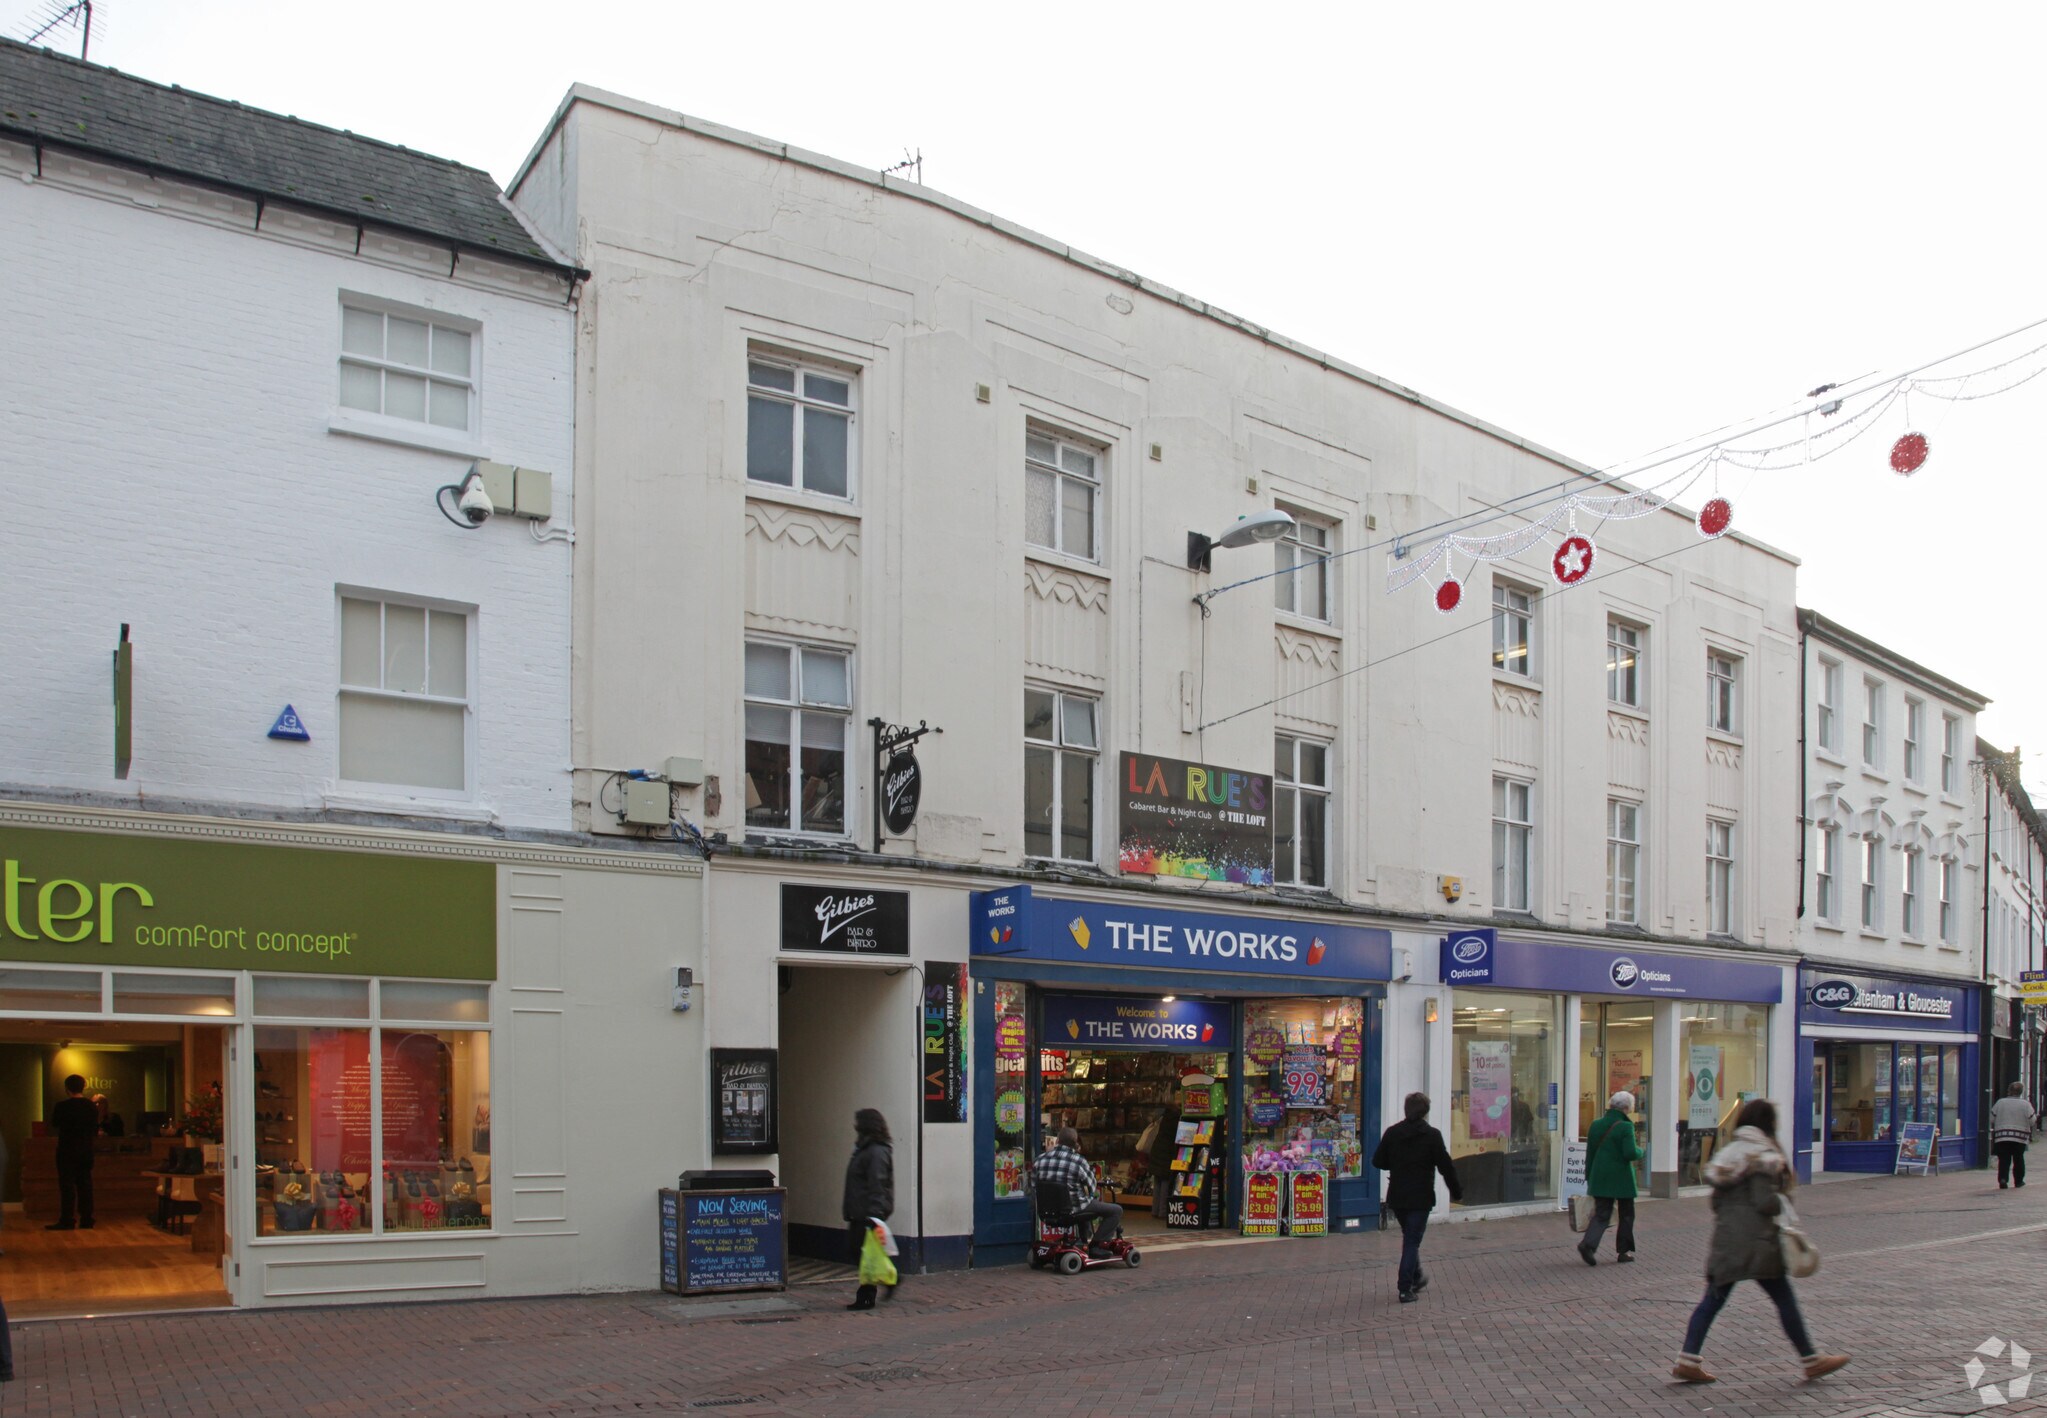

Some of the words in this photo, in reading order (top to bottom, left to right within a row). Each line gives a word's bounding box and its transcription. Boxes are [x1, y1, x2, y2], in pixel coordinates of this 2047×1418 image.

[887, 765, 915, 807] Gilbies
[1129, 757, 1168, 797] LA
[1188, 767, 1266, 811] RUE'S
[1129, 801, 1156, 812] Cabaret
[1157, 805, 1169, 814] Bar
[1170, 807, 1176, 815] &
[1178, 809, 1196, 819] Night
[1198, 811, 1212, 819] Club
[1219, 810, 1226, 821] @
[1227, 811, 1244, 824] THE
[1246, 814, 1266, 827] LOFT
[0, 859, 153, 943] ter
[993, 896, 1009, 906] THE
[814, 895, 876, 934] Gilbies
[988, 905, 1015, 917] WORKS
[136, 925, 247, 949] comfort
[847, 927, 863, 936] BAR
[866, 928, 874, 936] &
[847, 939, 877, 948] BISTRO
[1105, 920, 1173, 954] THE
[1183, 927, 1297, 961] WORKS
[1450, 968, 1488, 979] Opticians
[1641, 970, 1671, 982] Opticians
[1816, 987, 1849, 1001] C&G
[1898, 992, 1905, 1010] &
[1908, 993, 1952, 1013] Gloucester
[1116, 1006, 1156, 1018] Welcome
[1159, 1009, 1168, 1018] to
[925, 984, 945, 1054] RUE'S
[1085, 1021, 1123, 1037] THE
[1130, 1022, 1197, 1039] WORKS
[995, 1056, 1025, 1073] gica
[1041, 1054, 1064, 1071] ifts
[925, 1069, 945, 1100] LA
[1210, 1158, 1220, 1166] WE
[1567, 1158, 1579, 1166] Eye
[699, 1199, 724, 1215] NOW
[1169, 1202, 1183, 1212] WE
[1249, 1203, 1276, 1213] £3.99
[1296, 1203, 1321, 1212] £5.99
[1168, 1213, 1199, 1225] BOOKS
[1245, 1225, 1258, 1233] FOR
[1260, 1225, 1276, 1233] LESS
[1292, 1225, 1305, 1233] FOR
